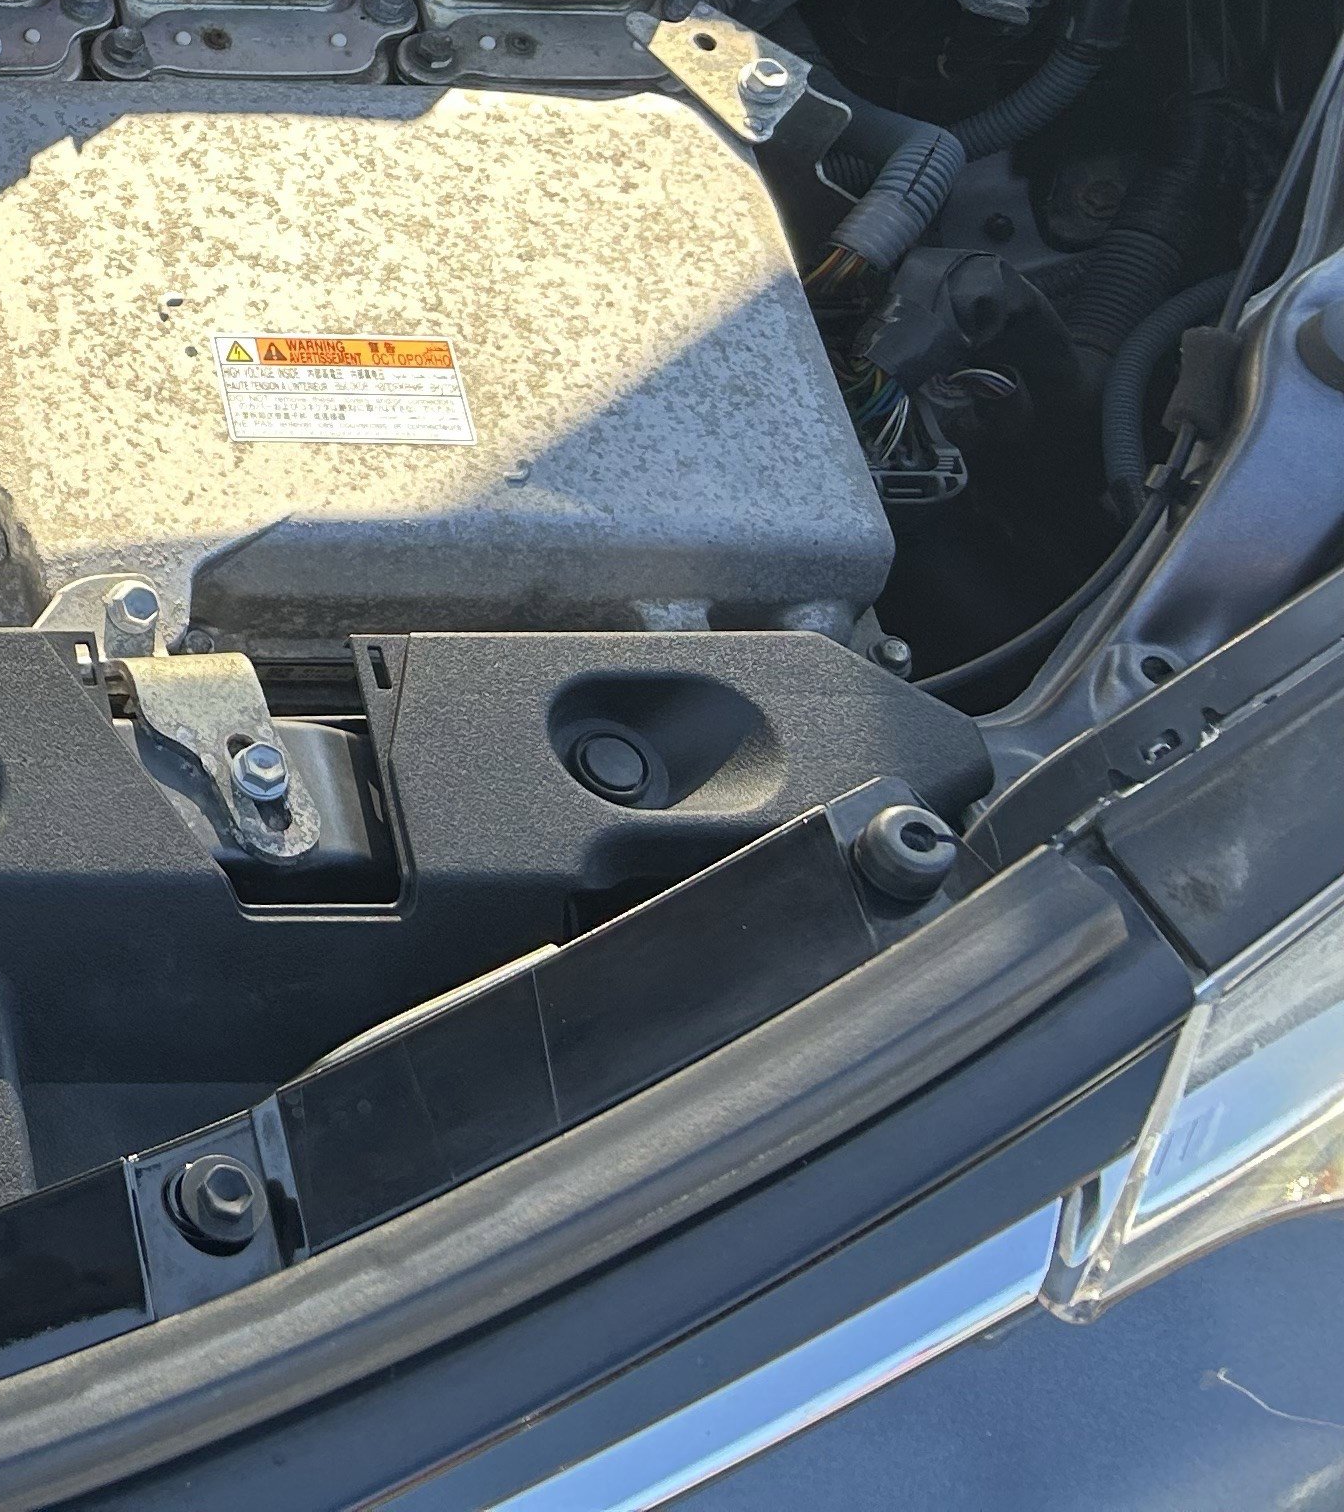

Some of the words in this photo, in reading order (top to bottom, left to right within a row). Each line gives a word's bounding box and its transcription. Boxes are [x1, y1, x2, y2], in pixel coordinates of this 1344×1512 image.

[285, 339, 345, 353] WARNING
[289, 352, 362, 366] AVERTISSEMENT
[372, 353, 452, 367] ОСТОРОЖНО
